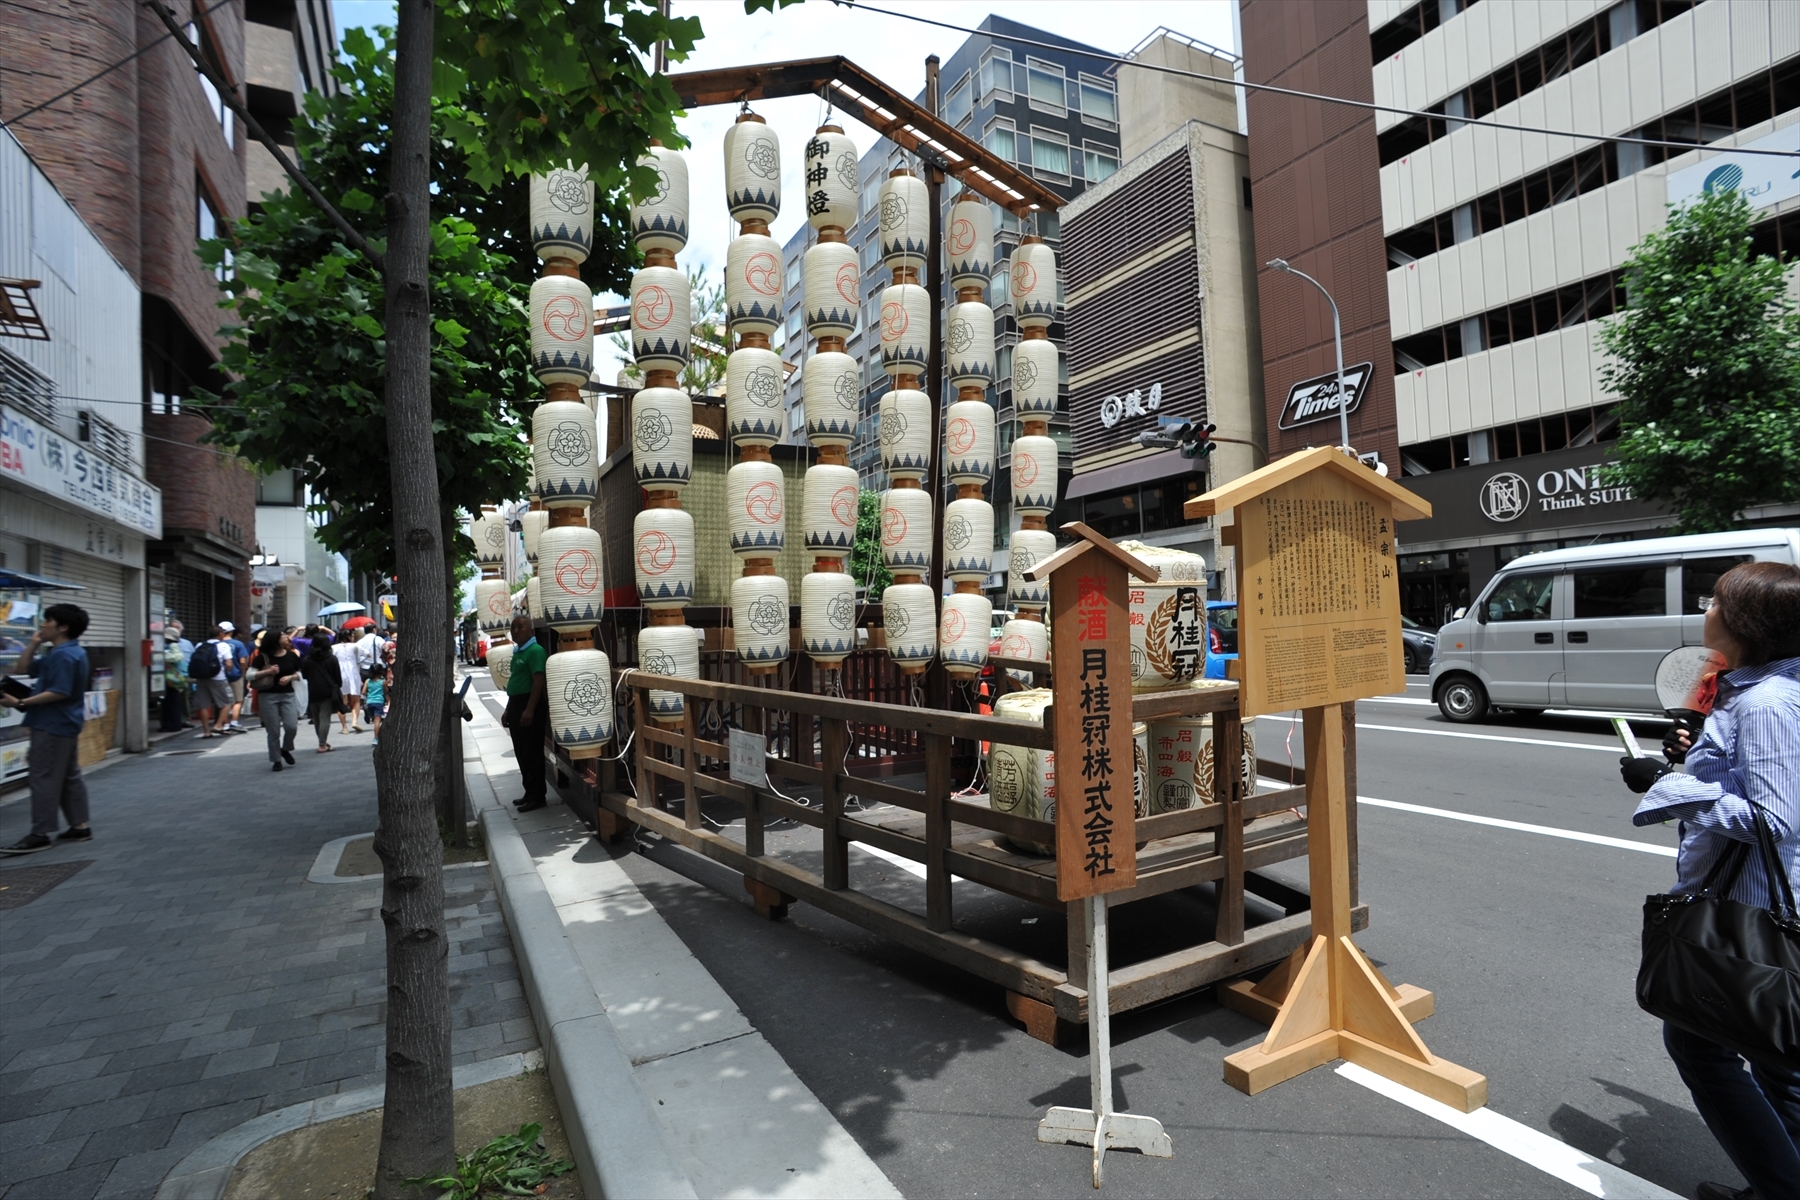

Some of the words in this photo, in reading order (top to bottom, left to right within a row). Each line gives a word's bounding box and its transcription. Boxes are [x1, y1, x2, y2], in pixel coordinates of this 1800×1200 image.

[806, 136, 830, 217] 御神燈
[1290, 376, 1360, 420] Times
[1318, 383, 1338, 397] 24h
[1537, 461, 1622, 496] ONL
[1540, 493, 1585, 511] Think
[1590, 486, 1637, 505] SUIT
[1379, 518, 1391, 579] 孟宗山
[1077, 575, 1109, 641] 献酒
[1169, 587, 1200, 682] 月桂冠
[1080, 648, 1116, 879] 月桂冠株式会社
